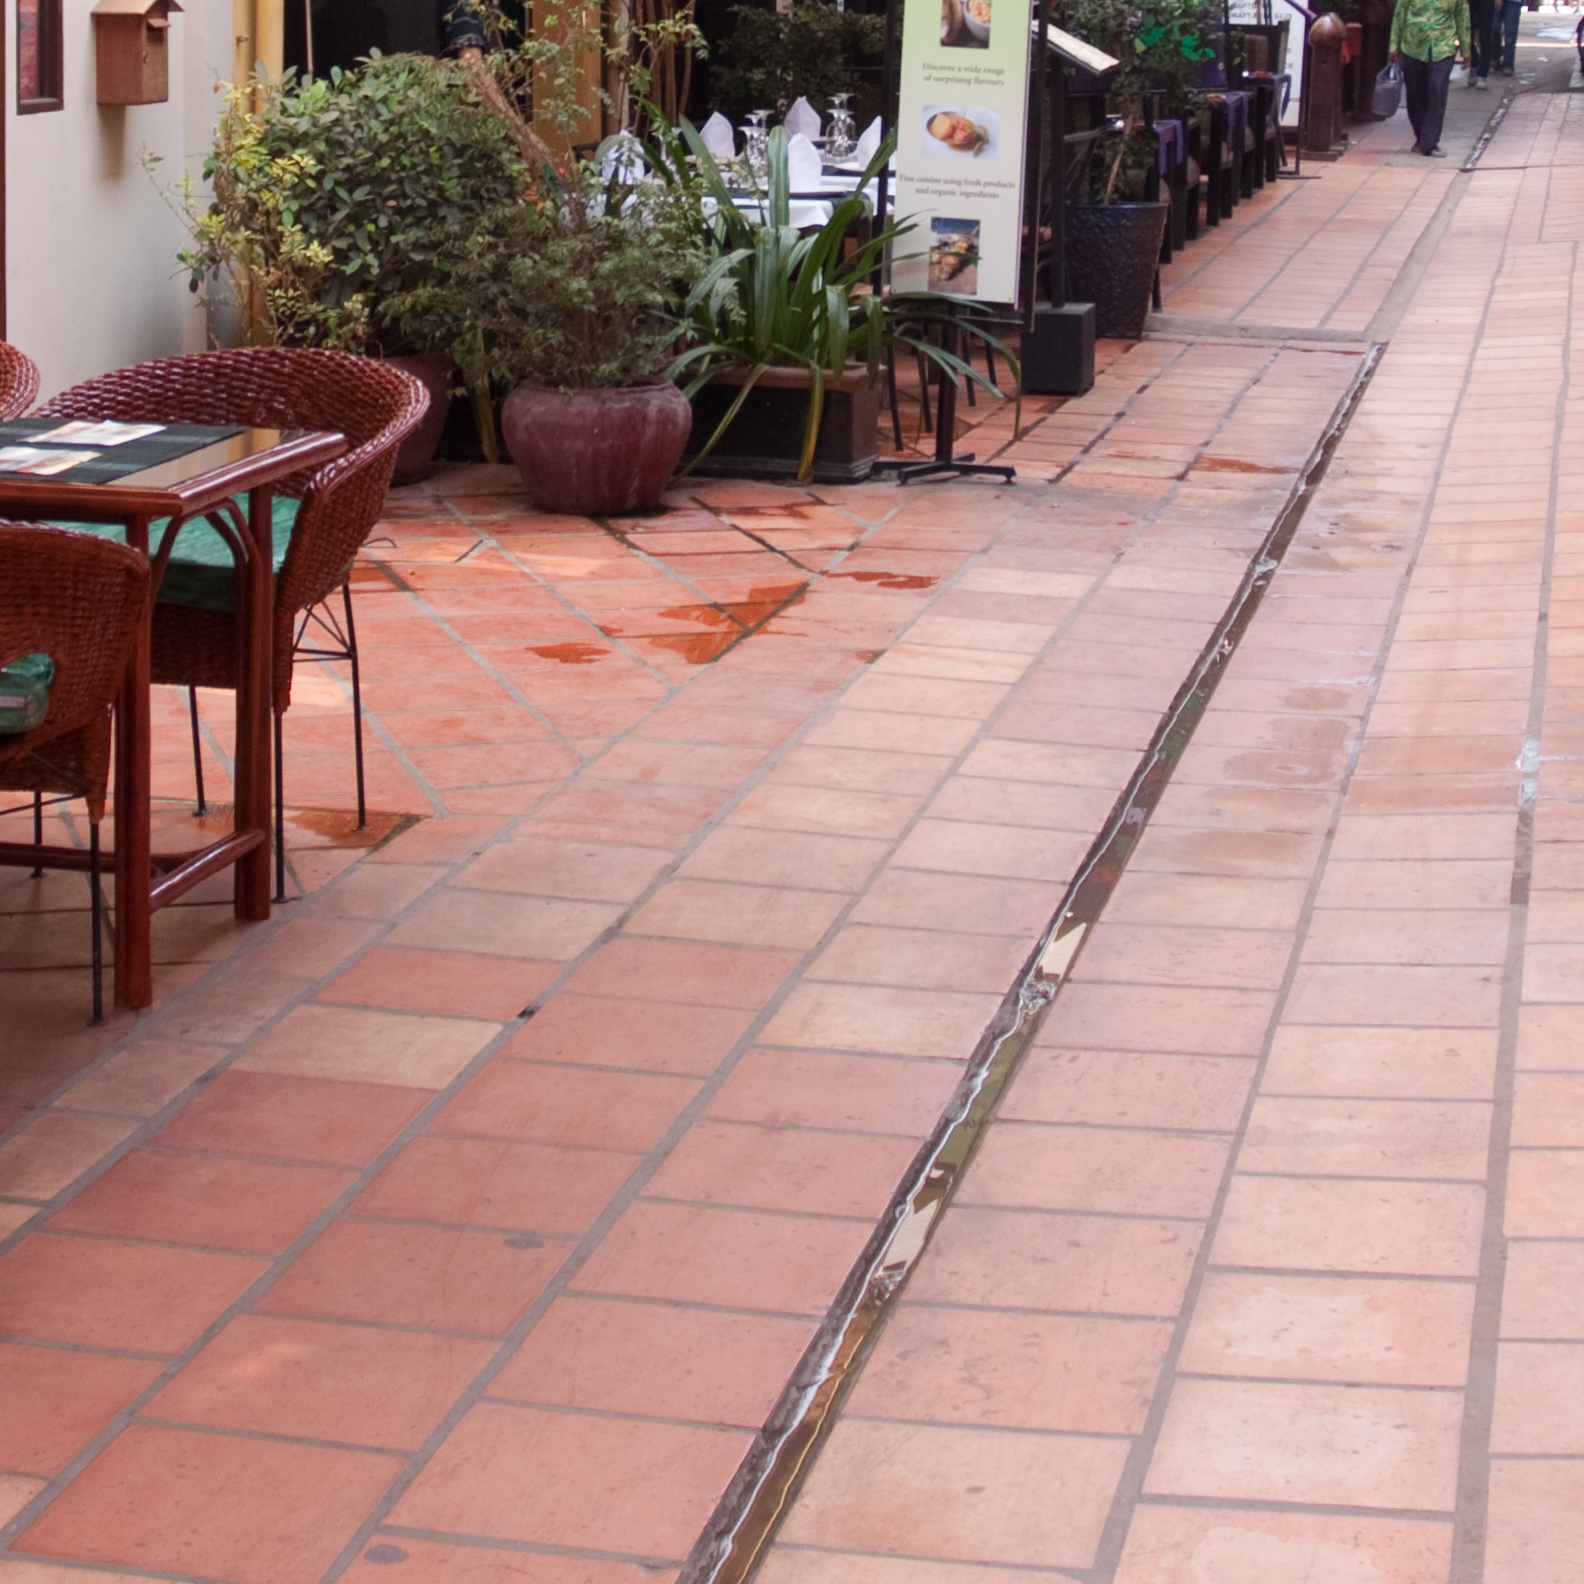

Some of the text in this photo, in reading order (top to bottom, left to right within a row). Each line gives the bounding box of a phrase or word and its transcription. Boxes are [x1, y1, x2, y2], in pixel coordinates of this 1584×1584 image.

[922, 62, 956, 73] Discover
[964, 65, 981, 74] wide
[983, 68, 1005, 77] range
[923, 74, 1005, 87] of surprising flavours
[899, 174, 1015, 190] Fine cuisine using fresh products
[915, 186, 1000, 200] and organic ingredients
